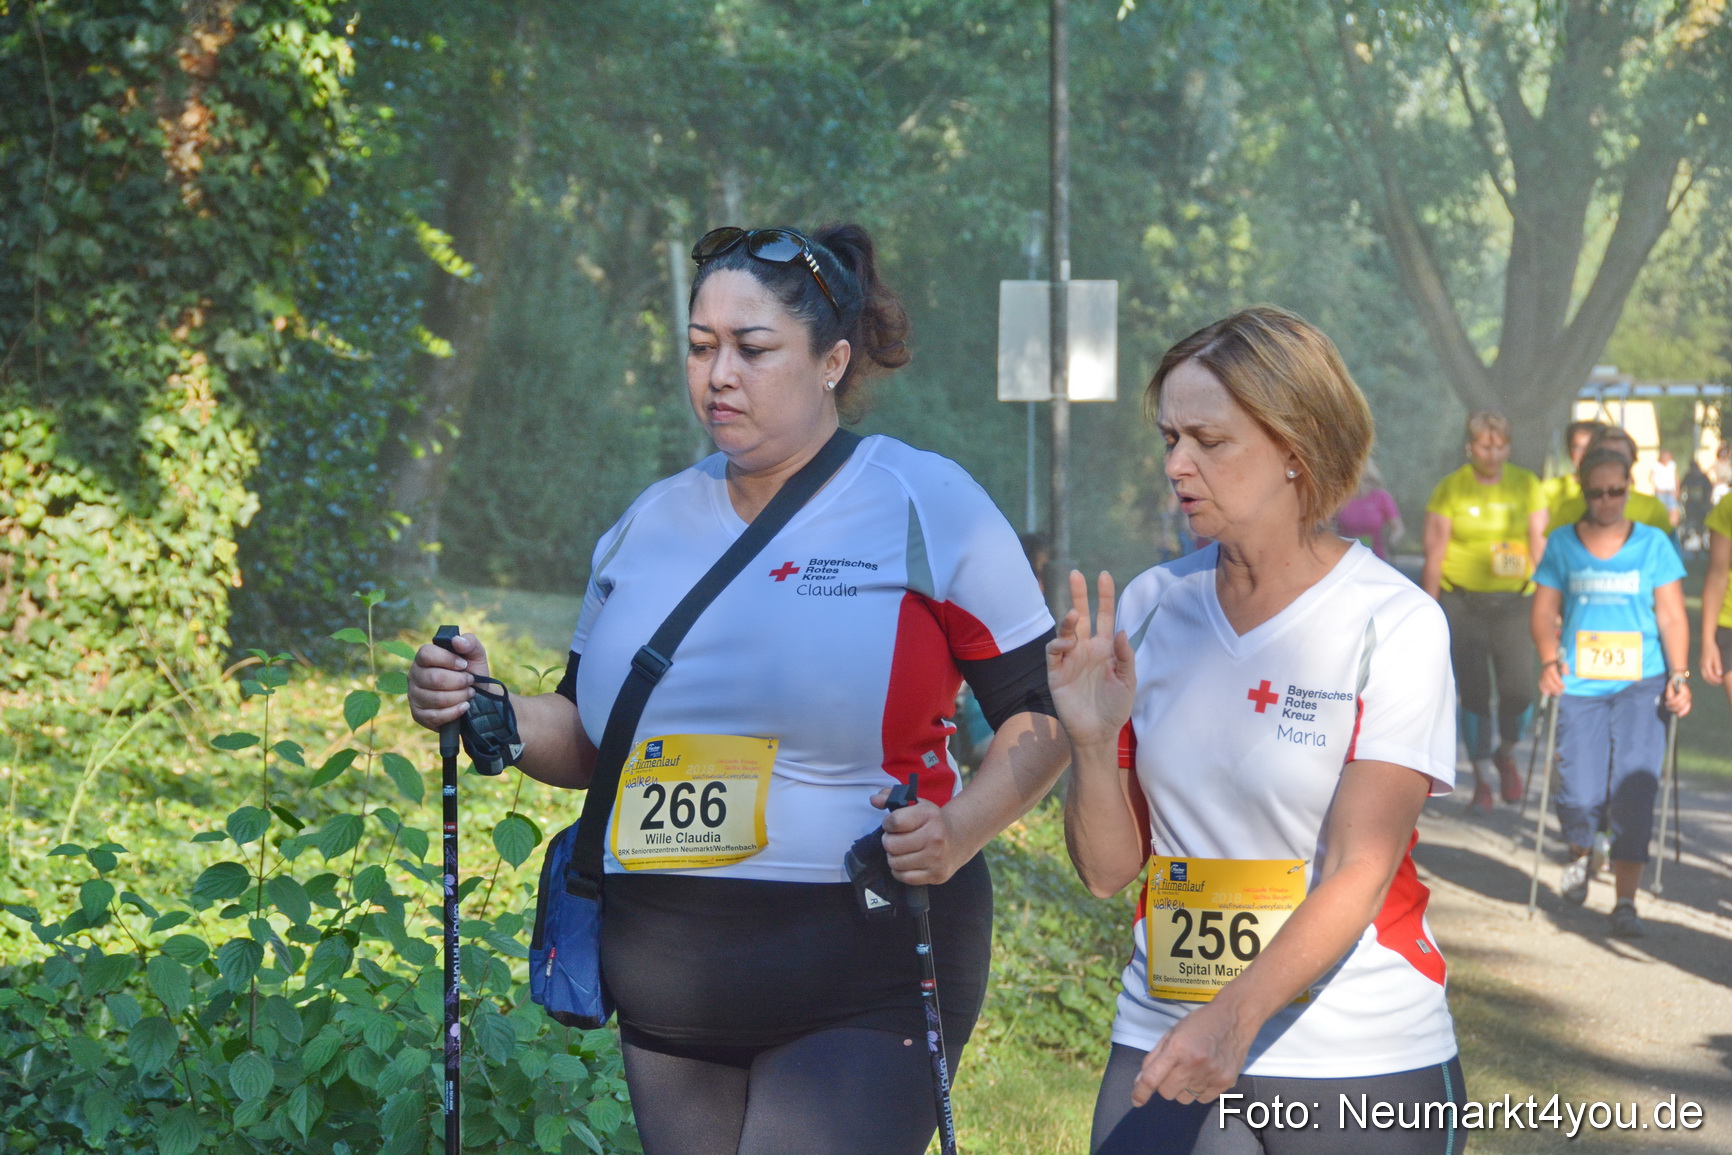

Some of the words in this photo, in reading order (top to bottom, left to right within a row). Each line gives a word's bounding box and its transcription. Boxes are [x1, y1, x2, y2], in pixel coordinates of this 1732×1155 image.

[805, 566, 839, 574] Rotes
[808, 558, 878, 571] Bayerisches
[796, 582, 858, 597] Claudia
[1591, 648, 1626, 665] 793
[1287, 685, 1354, 701] Bayerisches
[1284, 697, 1318, 710] Rotes
[1282, 708, 1316, 721] Kreuz
[1277, 724, 1327, 747] Maria
[636, 755, 681, 769] firmenlauf
[640, 781, 727, 830] 266
[645, 834, 672, 845] Wille
[675, 832, 721, 844] Claudia
[631, 846, 679, 855] Seniorenzentren
[680, 844, 757, 853] Neumarkt/Woffenbach
[1162, 879, 1206, 892] firmenlauf
[1170, 911, 1261, 962] 256
[1179, 962, 1211, 977] Spital
[1214, 964, 1243, 977] Mari
[1153, 974, 1163, 982] BRK
[1163, 975, 1210, 985] Seniorenzentren
